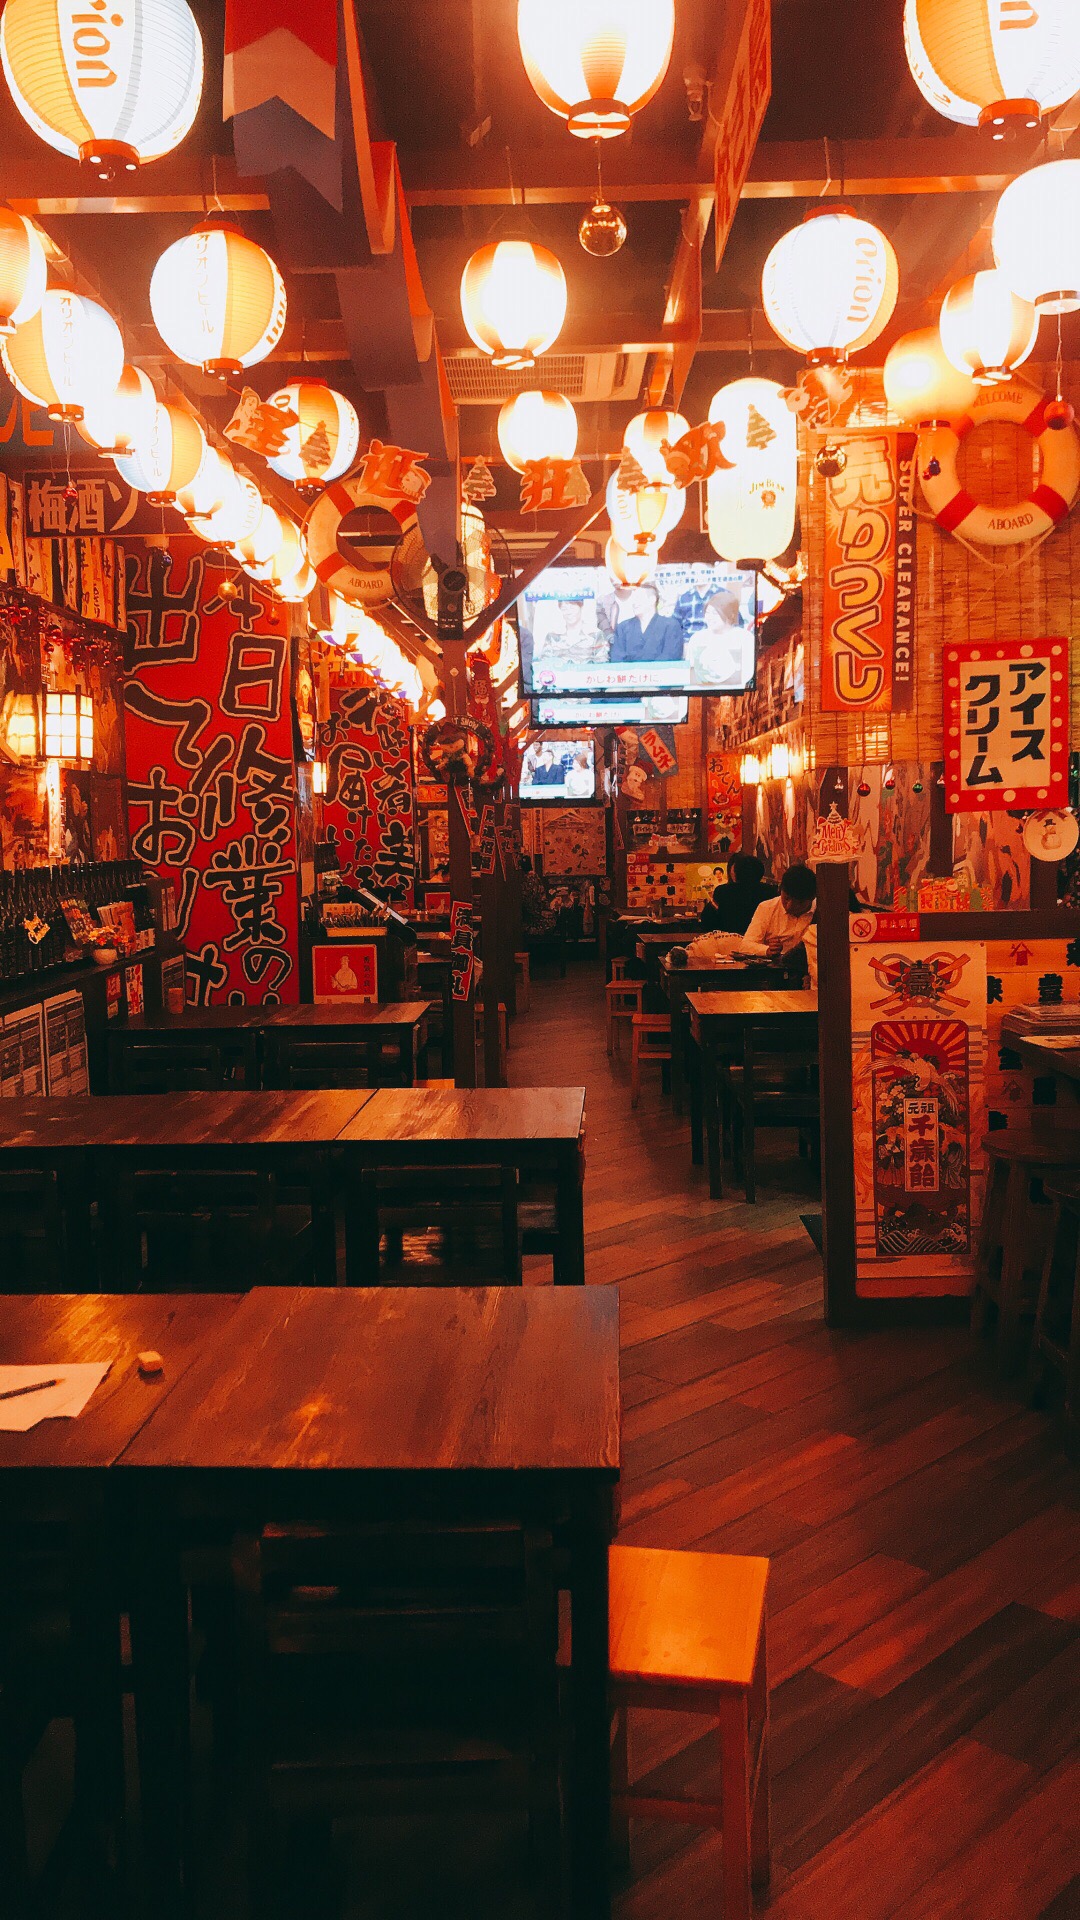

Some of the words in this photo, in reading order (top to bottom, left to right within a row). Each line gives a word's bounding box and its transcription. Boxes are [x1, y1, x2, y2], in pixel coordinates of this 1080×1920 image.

[897, 459, 913, 532] SUPER
[987, 512, 1034, 531] ABOARD
[349, 578, 384, 590] ABOARD
[828, 436, 896, 703] 売りつくし
[895, 543, 912, 683] CLEARANCE!
[964, 674, 1004, 787] クリーム
[1008, 661, 1047, 763] アイス
[643, 732, 673, 770] ラムネ
[708, 757, 741, 795] おでん
[822, 823, 849, 845] Merry
[907, 1101, 936, 1115] 元祖
[907, 1114, 936, 1189] 千歳飴
